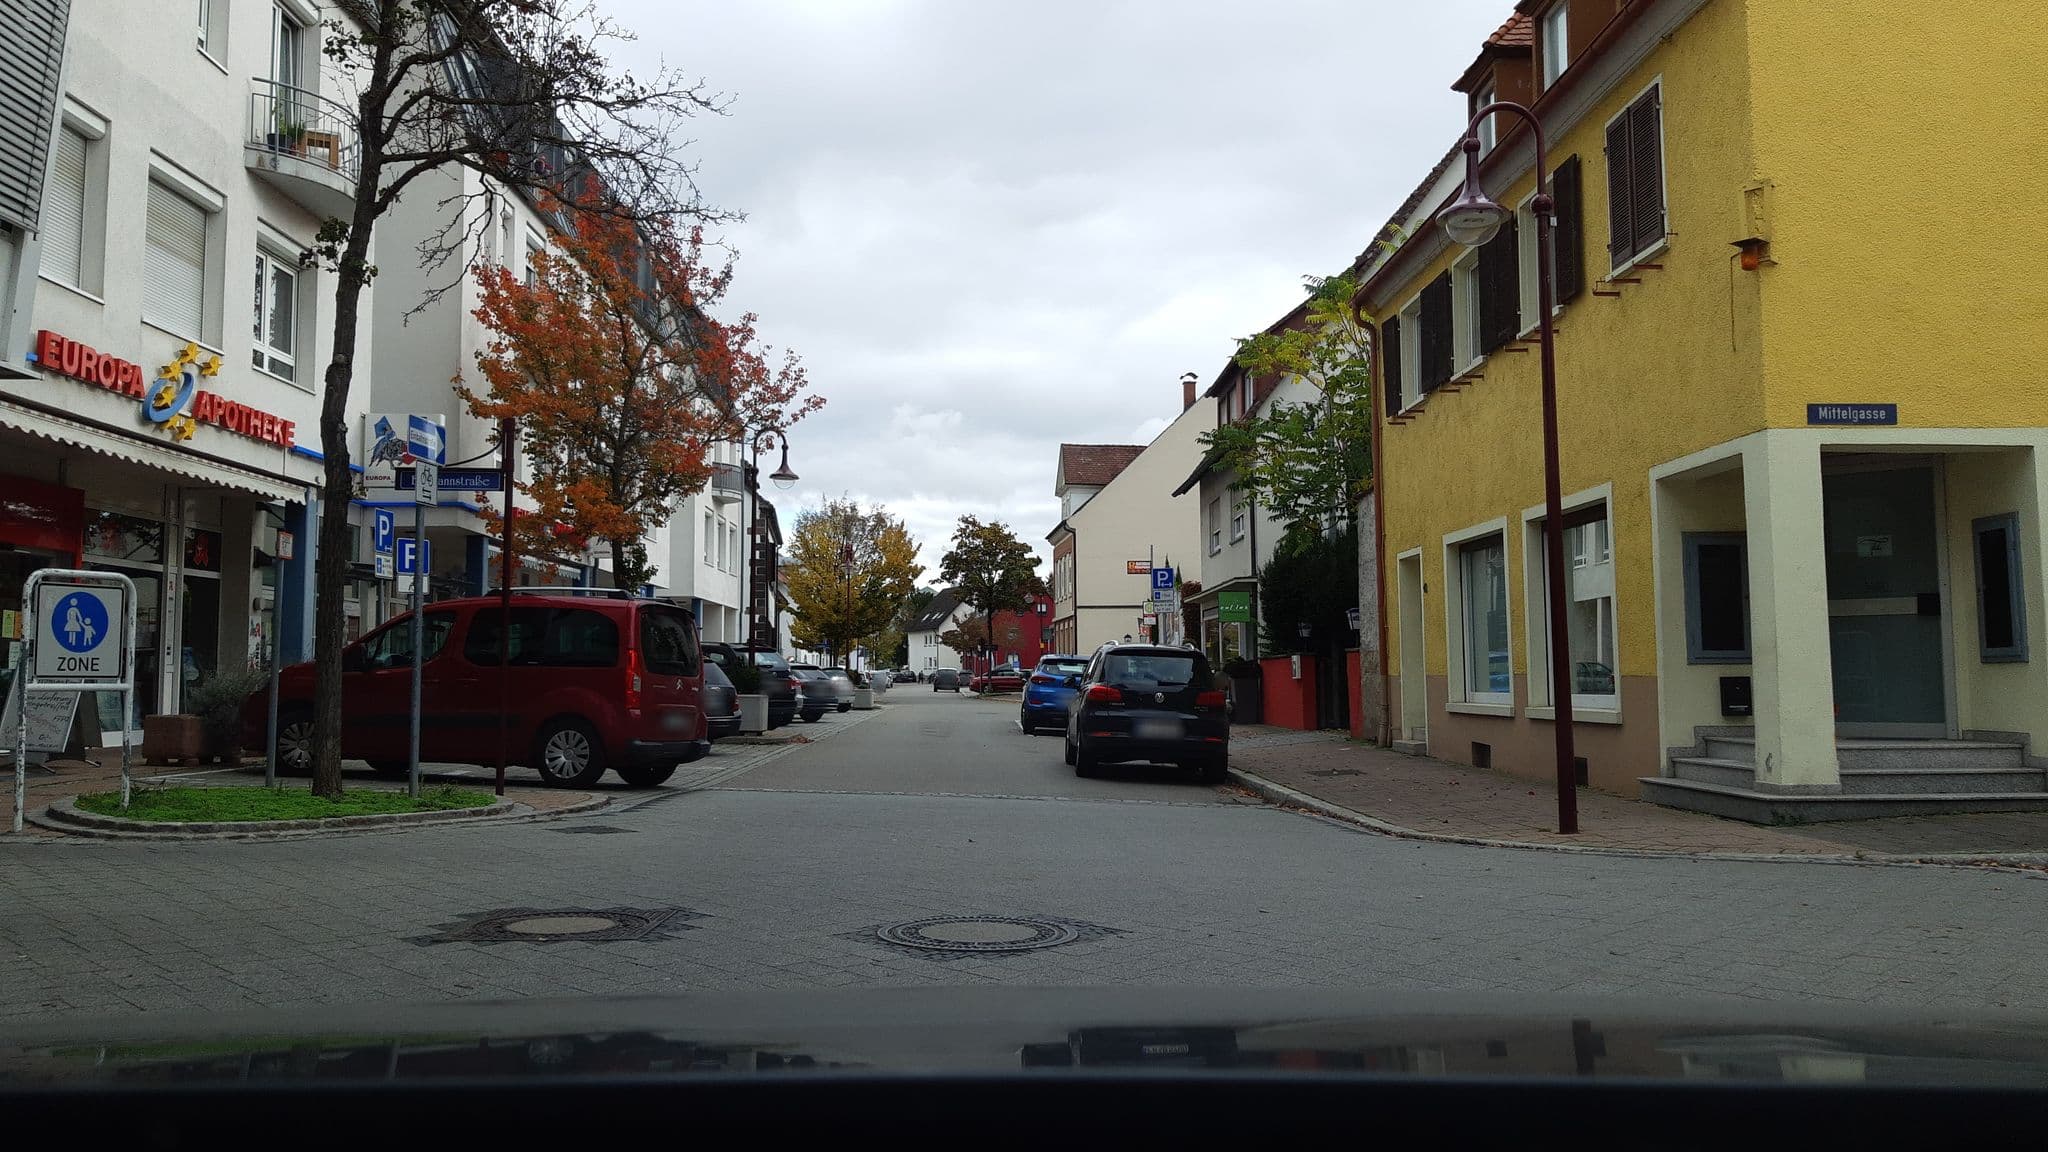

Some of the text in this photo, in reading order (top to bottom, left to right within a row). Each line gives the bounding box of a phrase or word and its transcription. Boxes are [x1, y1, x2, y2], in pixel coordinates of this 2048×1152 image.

[37, 330, 296, 448] EUROPA APOTHEKE
[1818, 406, 1886, 422] Mittelgasse
[379, 514, 390, 547] P
[1157, 570, 1169, 587] P
[57, 656, 100, 672] ZONE
